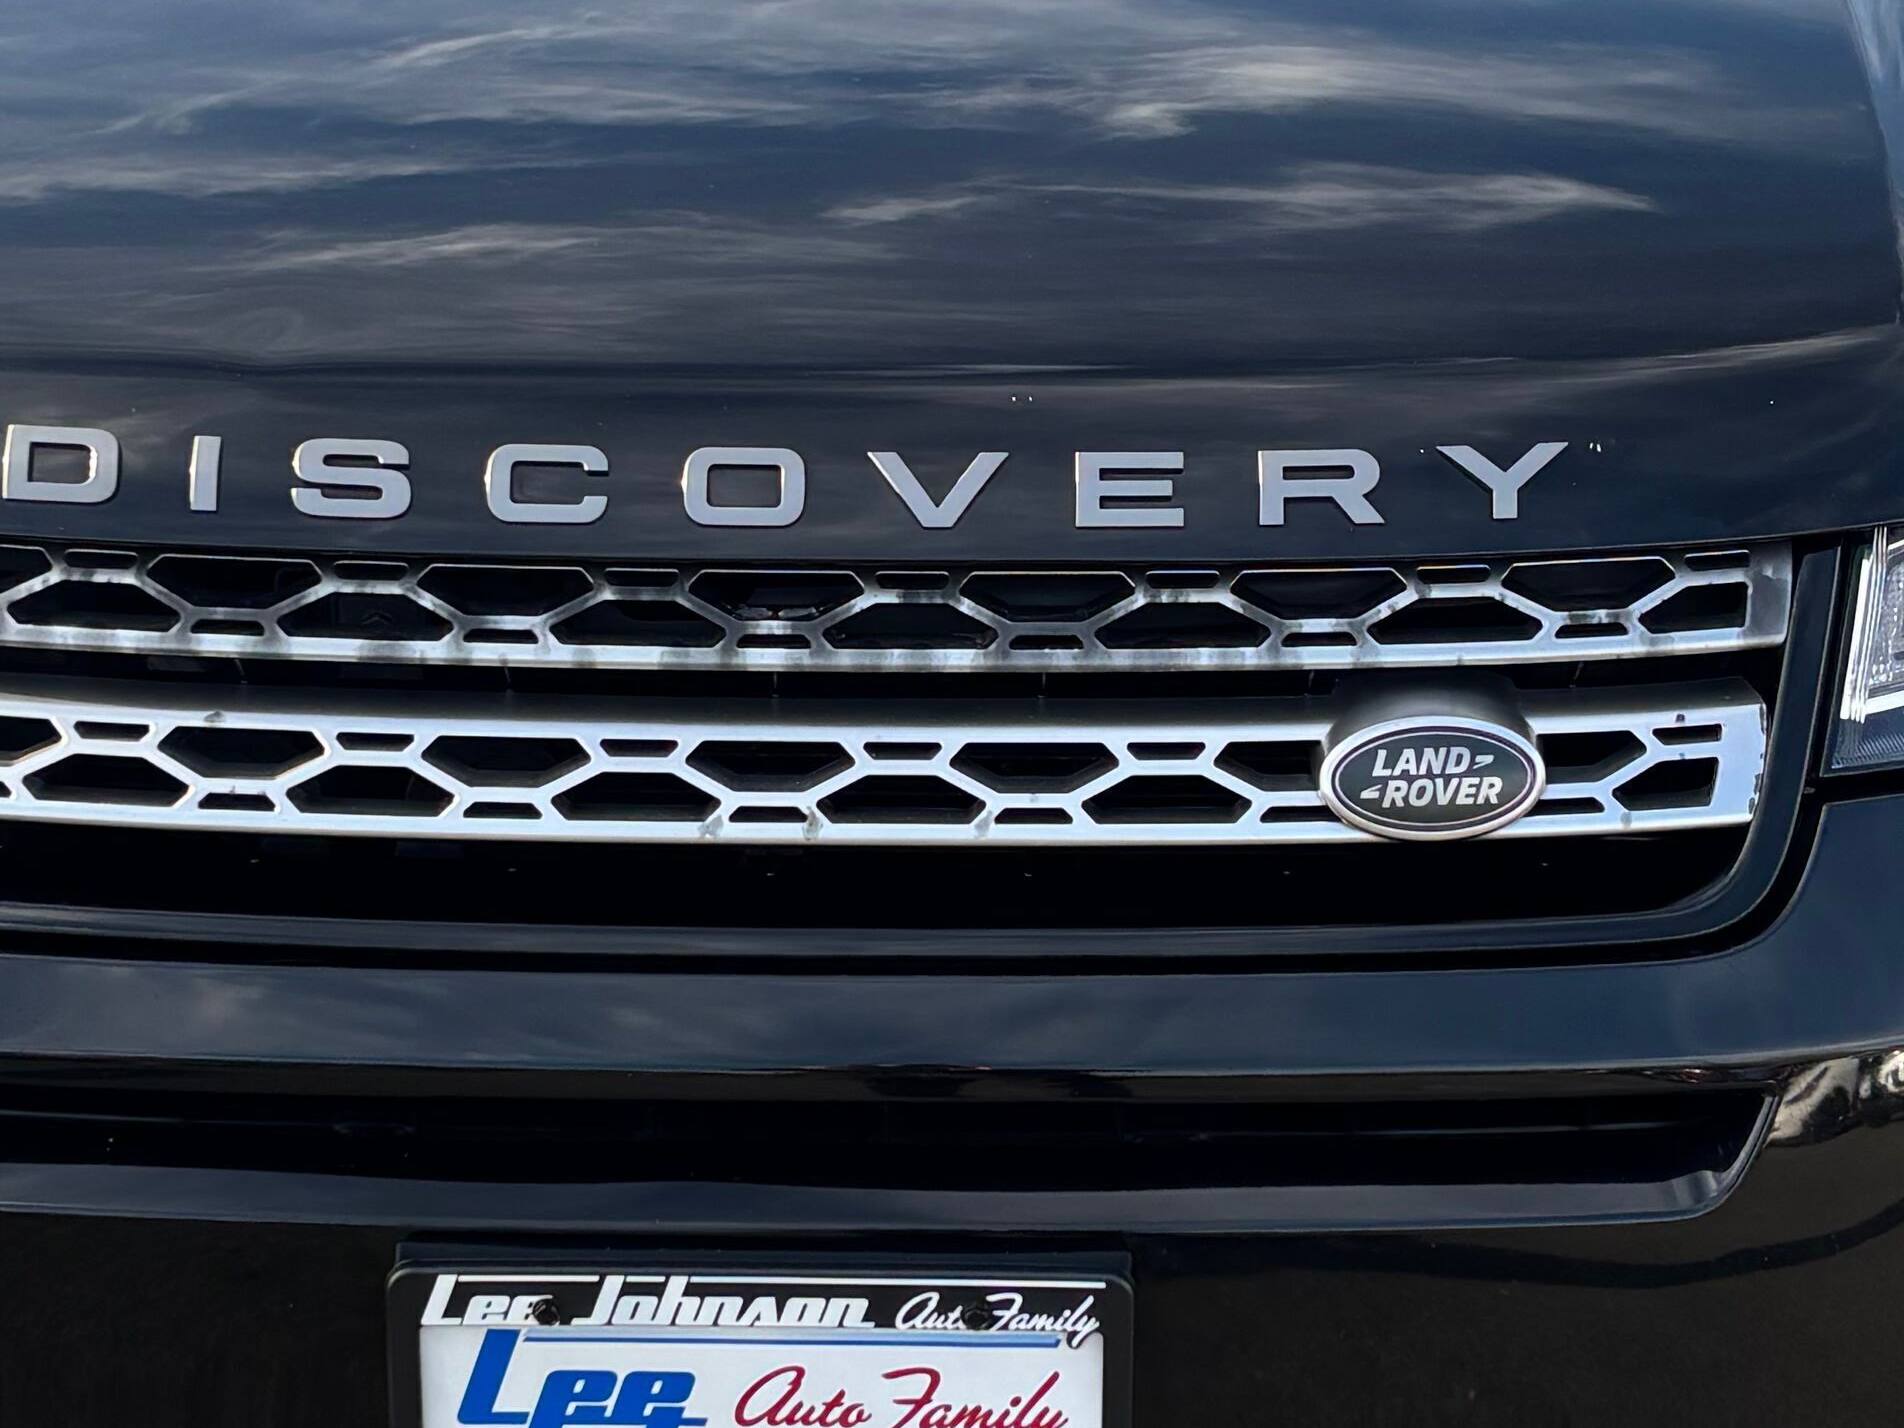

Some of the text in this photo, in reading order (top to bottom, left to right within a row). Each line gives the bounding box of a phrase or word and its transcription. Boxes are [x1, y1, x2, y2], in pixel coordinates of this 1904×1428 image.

[2, 423, 1569, 529] DISCOVERY
[1372, 746, 1472, 777] LAND
[1382, 776, 1504, 808] ROVER
[571, 1275, 876, 1328] Johnson
[895, 1291, 970, 1330] Aut
[985, 1292, 1101, 1348] Family
[457, 1329, 708, 1428] Lee
[734, 1365, 873, 1428] Auto
